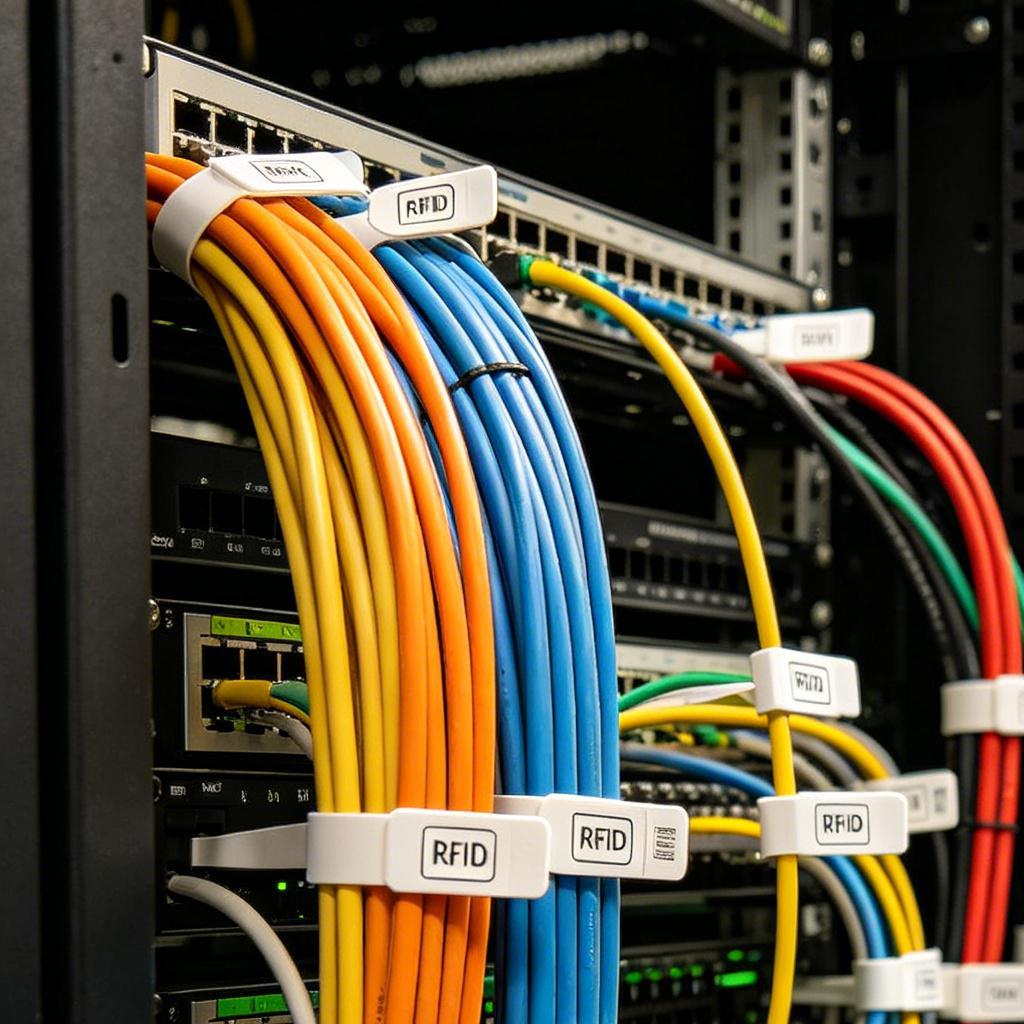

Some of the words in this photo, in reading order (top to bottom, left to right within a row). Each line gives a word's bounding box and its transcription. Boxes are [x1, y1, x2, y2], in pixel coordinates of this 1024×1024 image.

[823, 814, 863, 833] RFID
[580, 826, 627, 851] RFID
[433, 839, 488, 867] RFID
